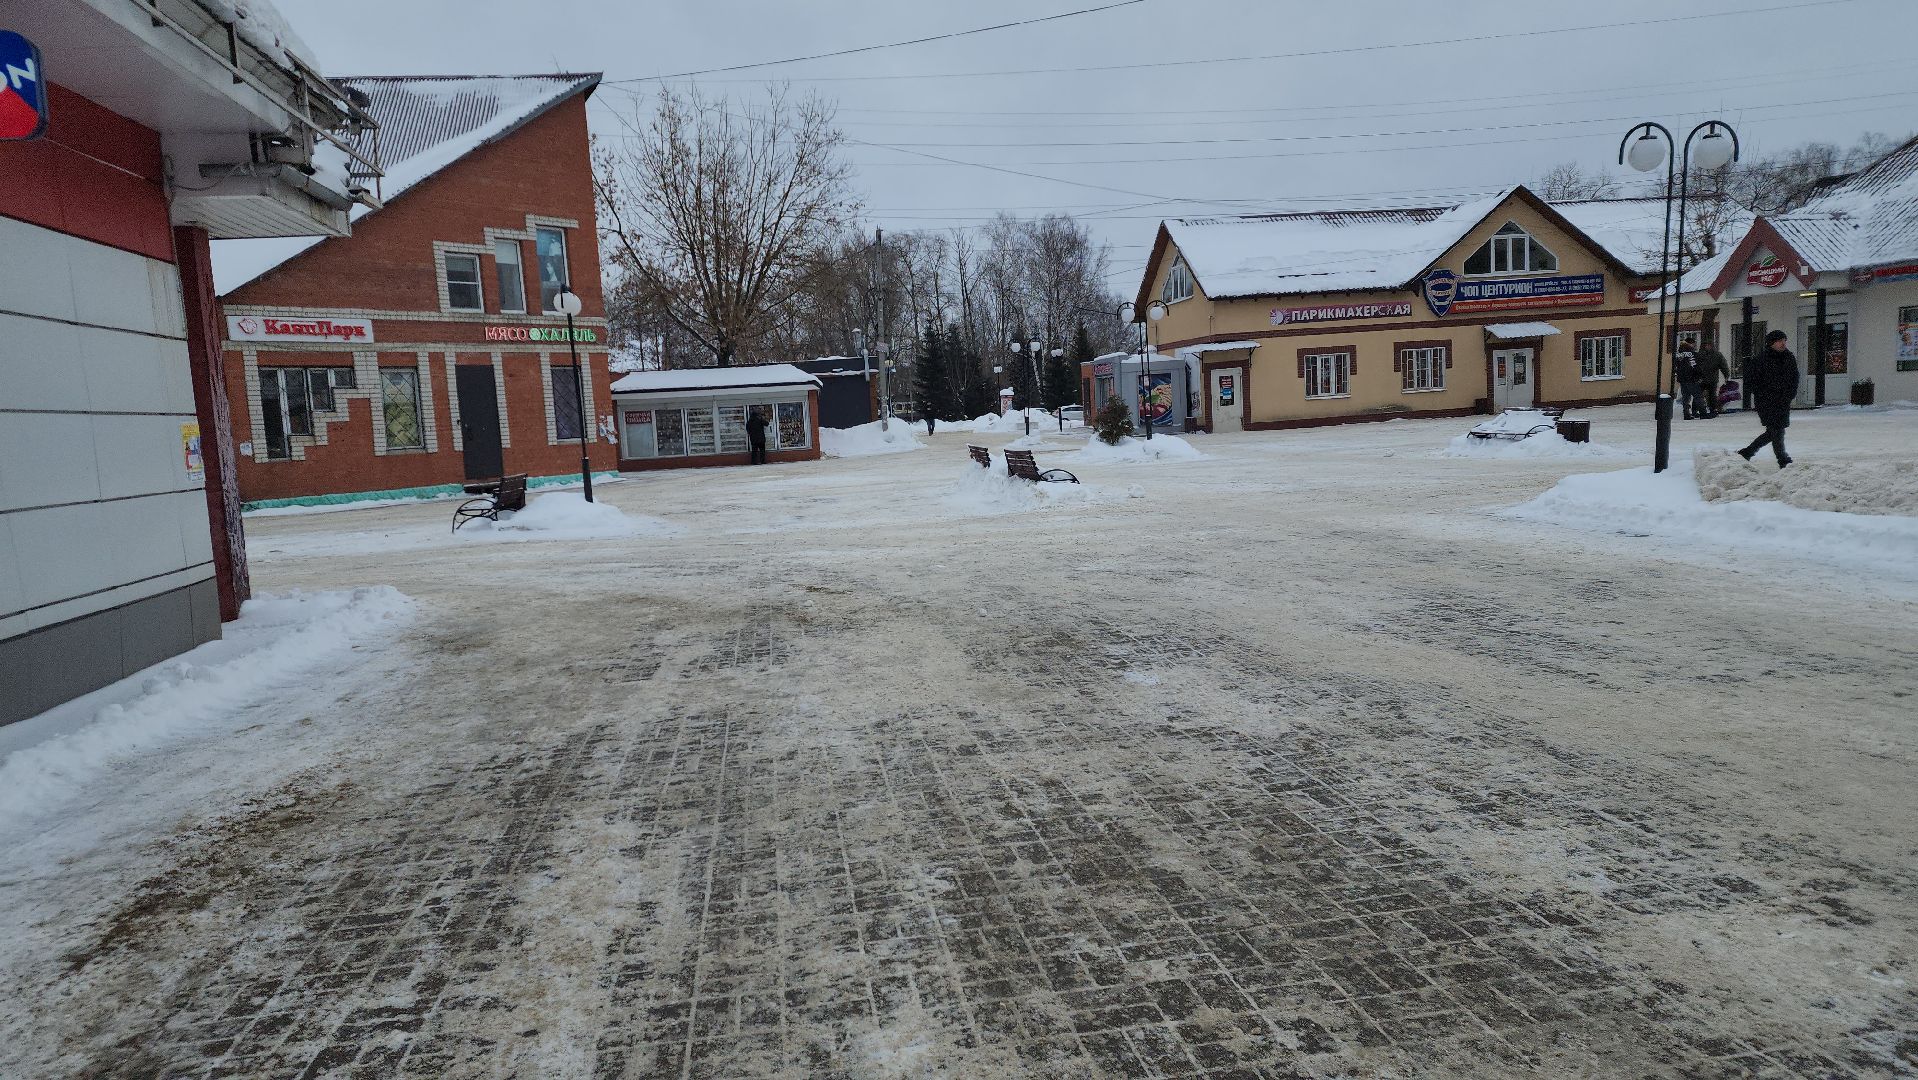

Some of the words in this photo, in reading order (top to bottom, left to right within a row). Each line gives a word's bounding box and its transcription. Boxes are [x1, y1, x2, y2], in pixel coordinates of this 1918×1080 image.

[1461, 285, 1479, 298] ЧОП
[1481, 282, 1533, 298] ЦЕНТУРИОН
[1292, 303, 1411, 322] ПАРИКМАХЕРСКАЯ
[263, 319, 366, 341] КанцПарк
[485, 326, 527, 341] МЯСО
